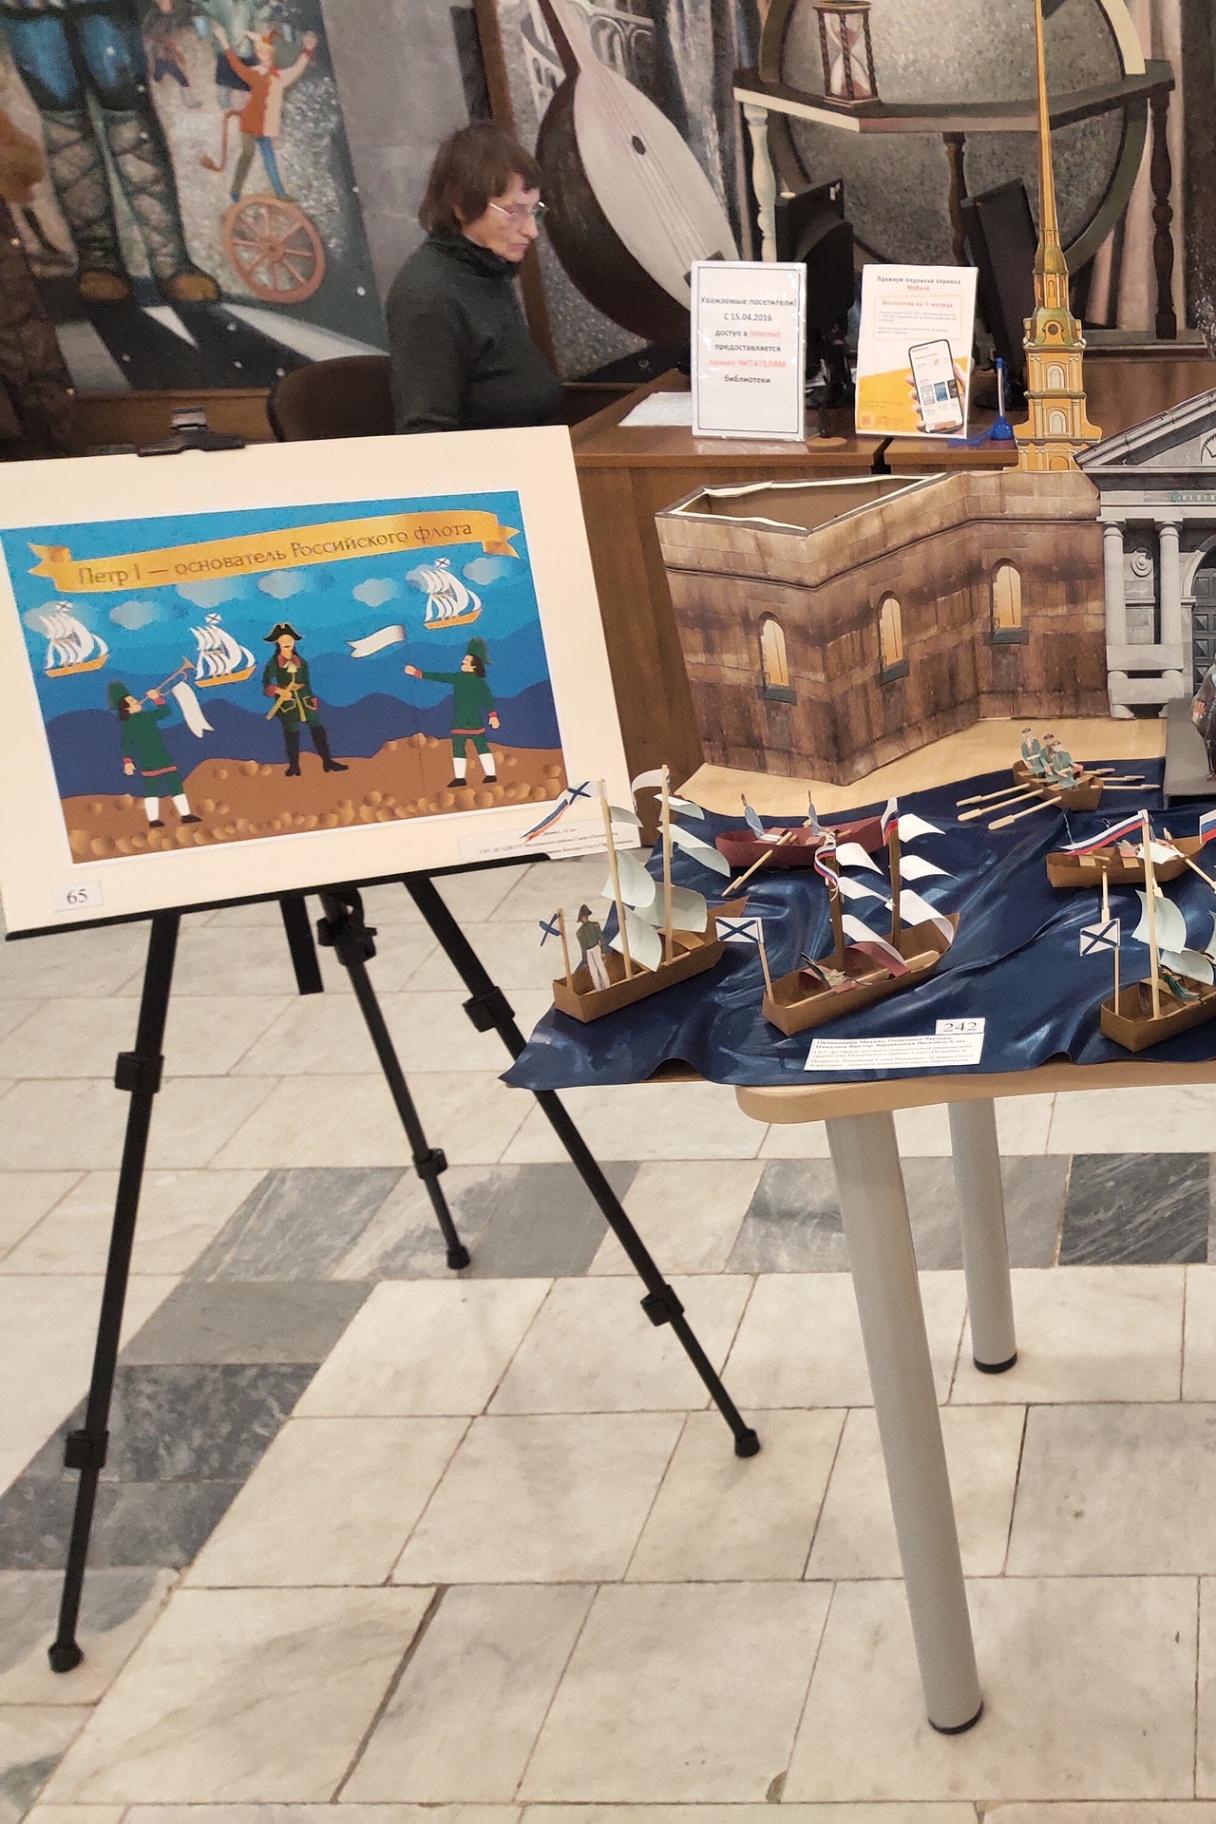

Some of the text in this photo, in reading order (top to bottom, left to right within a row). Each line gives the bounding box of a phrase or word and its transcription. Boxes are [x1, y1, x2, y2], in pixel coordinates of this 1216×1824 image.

[701, 296, 748, 305] Уважаемые
[715, 329, 742, 338] доступ
[715, 344, 781, 352] предоставляется
[724, 375, 771, 383] библиотеки
[78, 566, 129, 586] Петр
[174, 550, 287, 575] основатель
[290, 531, 409, 557] Российского
[413, 523, 473, 544] флота
[66, 888, 89, 905] 65
[943, 1021, 978, 1033] 242
